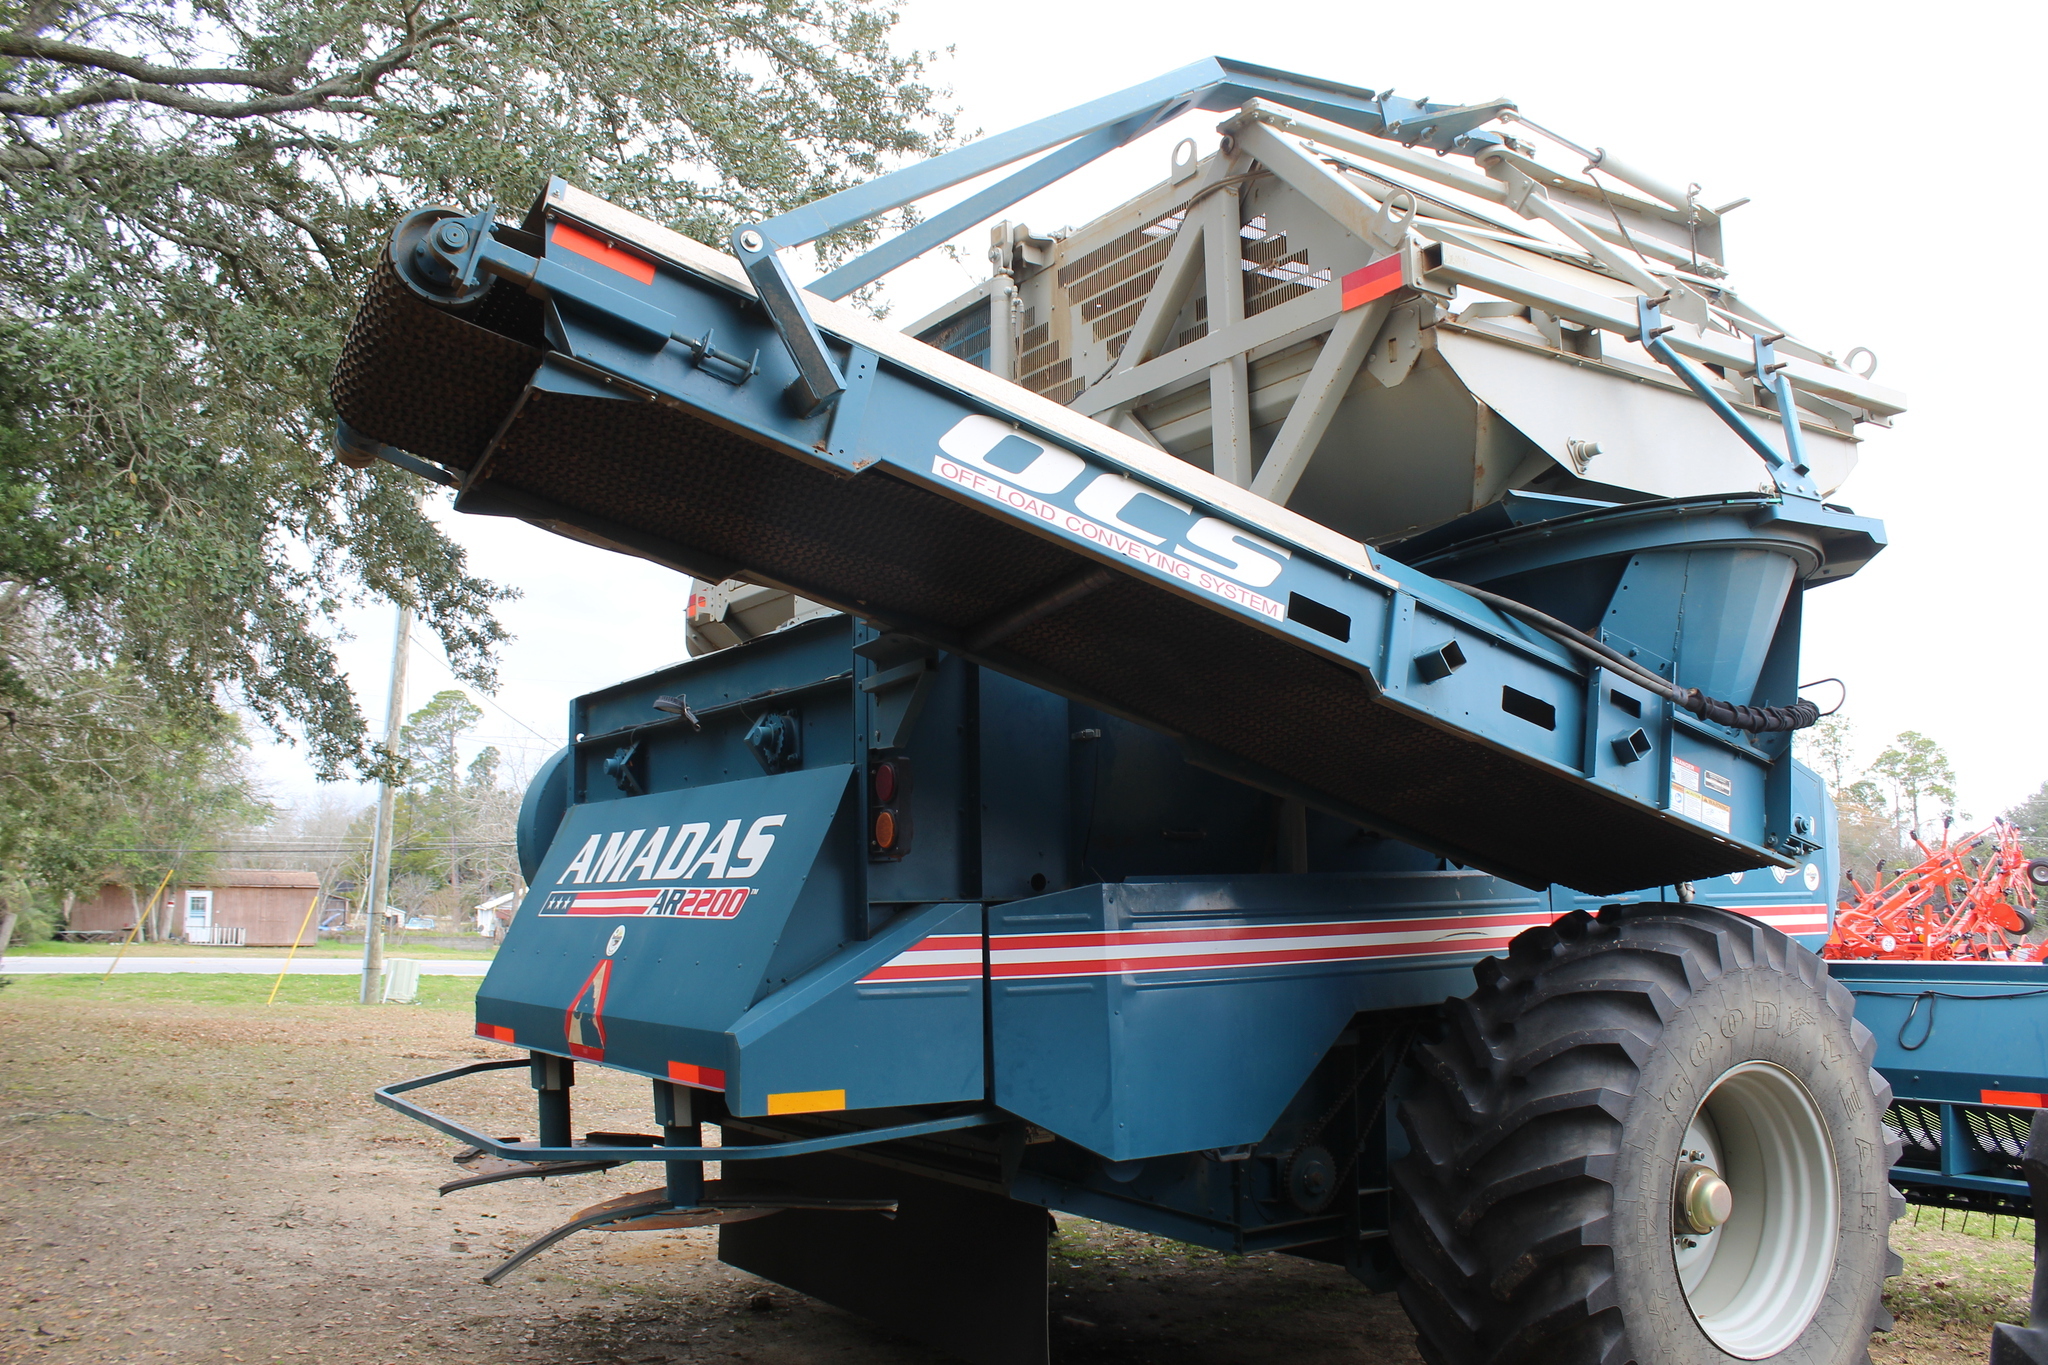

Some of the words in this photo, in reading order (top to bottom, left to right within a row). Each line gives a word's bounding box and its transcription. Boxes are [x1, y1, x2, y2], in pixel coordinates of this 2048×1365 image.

[938, 414, 1292, 588] OCS
[941, 462, 1056, 521] OFF-LOAD
[1065, 516, 1190, 580] CONVEYING
[1199, 573, 1278, 618] SYSTEM
[556, 813, 787, 885] AMADAS
[646, 888, 749, 917] AR2200
